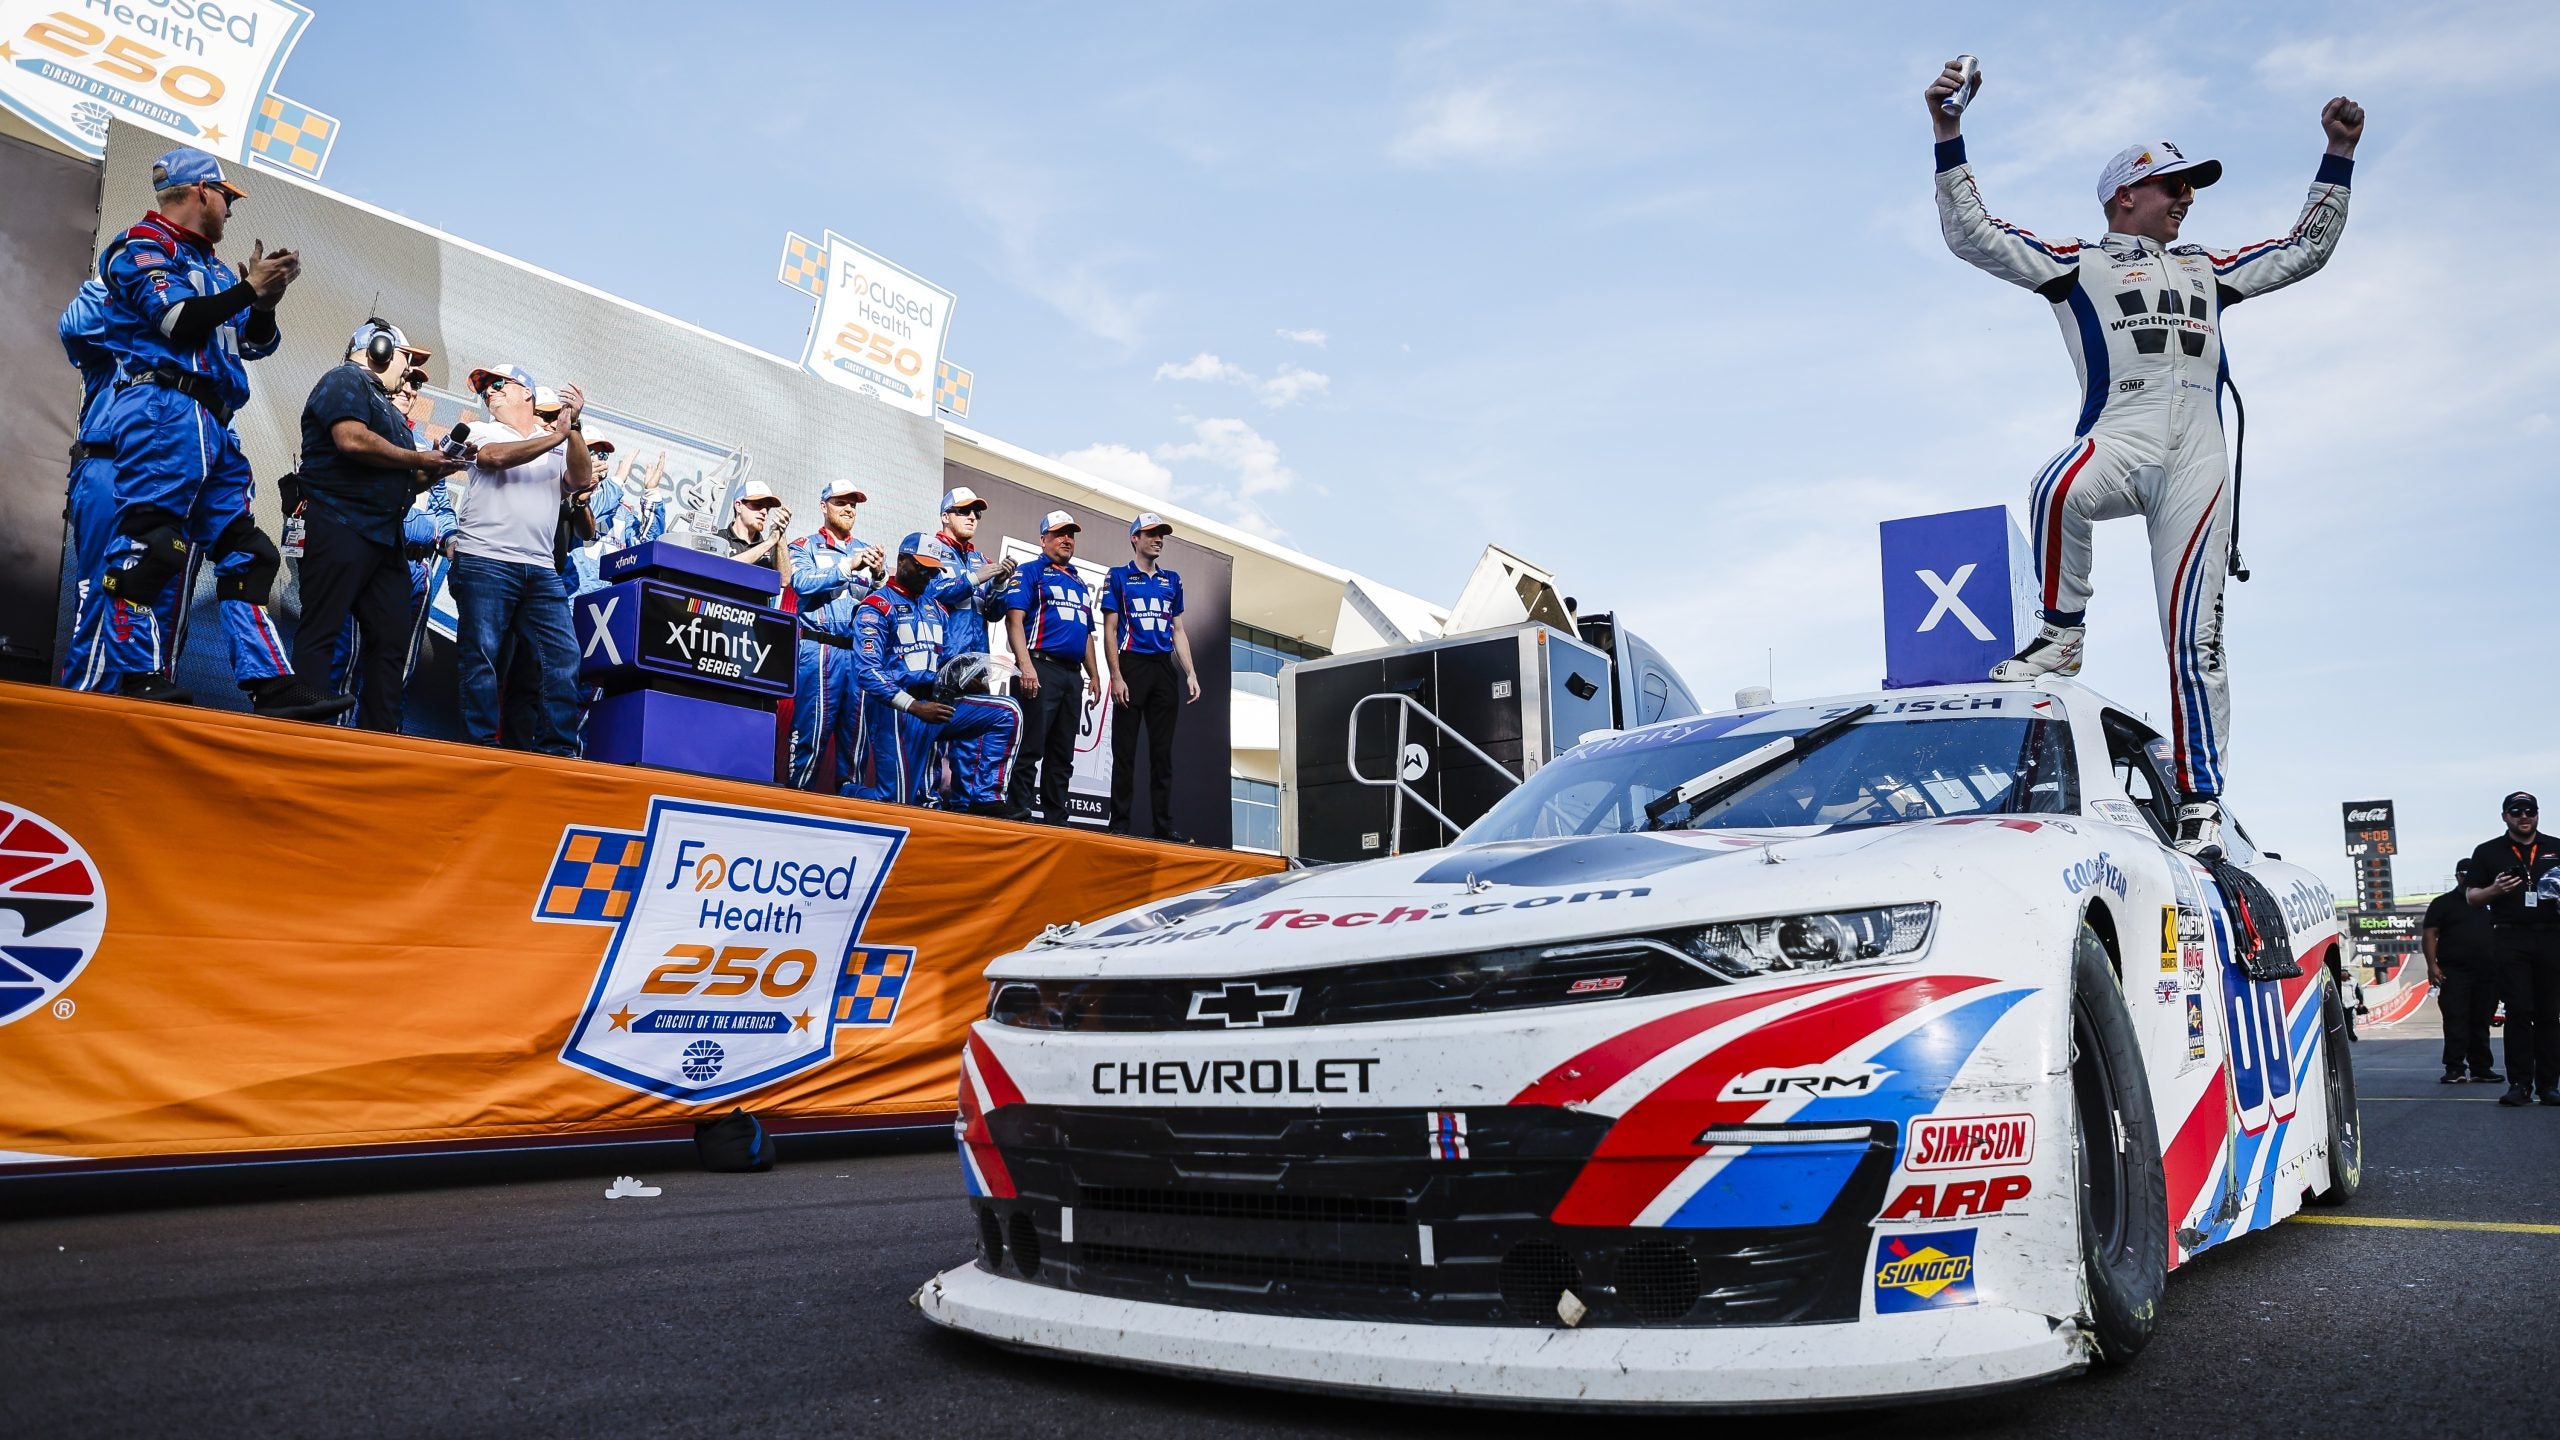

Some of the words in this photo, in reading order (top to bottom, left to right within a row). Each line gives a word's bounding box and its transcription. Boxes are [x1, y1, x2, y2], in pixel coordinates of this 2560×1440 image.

[85, 0, 204, 57] Health
[24, 12, 225, 107] 250
[41, 63, 86, 90] CIRCUIT
[89, 82, 104, 96] OF
[107, 88, 127, 106] THE
[128, 99, 182, 127] AMERICAS
[840, 261, 933, 328] Focused
[859, 300, 911, 340] Health
[2111, 314, 2214, 335] WeatherTech
[835, 322, 922, 377] 250
[2120, 381, 2145, 391] OMP
[615, 554, 638, 569] xfinity
[704, 601, 756, 627] NASCAR
[1915, 563, 1997, 642] X
[2043, 628, 2058, 637] OMP
[666, 618, 772, 674] xfinity
[697, 657, 742, 678] SERIES
[1820, 698, 2002, 720] ZLISCH
[1563, 722, 1712, 761] xfinity
[1069, 799, 1102, 813] TEXAS
[2360, 830, 2389, 841] 4:08
[2347, 844, 2368, 855] LAP
[667, 840, 857, 901] Focused
[2356, 860, 2363, 868] 1
[2357, 870, 2365, 880] 2
[2358, 880, 2366, 891] 3
[2359, 891, 2366, 900] 4
[699, 899, 802, 934] Health
[2360, 902, 2367, 912] 5
[2178, 914, 2204, 936] COMETIC
[2359, 916, 2415, 929] EchoPark
[640, 944, 818, 998] 250
[654, 1014, 696, 1029] CIRCUIT
[697, 1015, 709, 1029] OF
[712, 1015, 731, 1029] THE
[731, 1016, 776, 1030] AMERICAS
[1093, 1058, 1381, 1095] CHEVROLET
[1732, 1075, 1870, 1098] JRM
[1917, 1121, 2026, 1165] SIMPSON
[1879, 1175, 2032, 1218] ARP
[1880, 1256, 1970, 1286] SUNOCO
